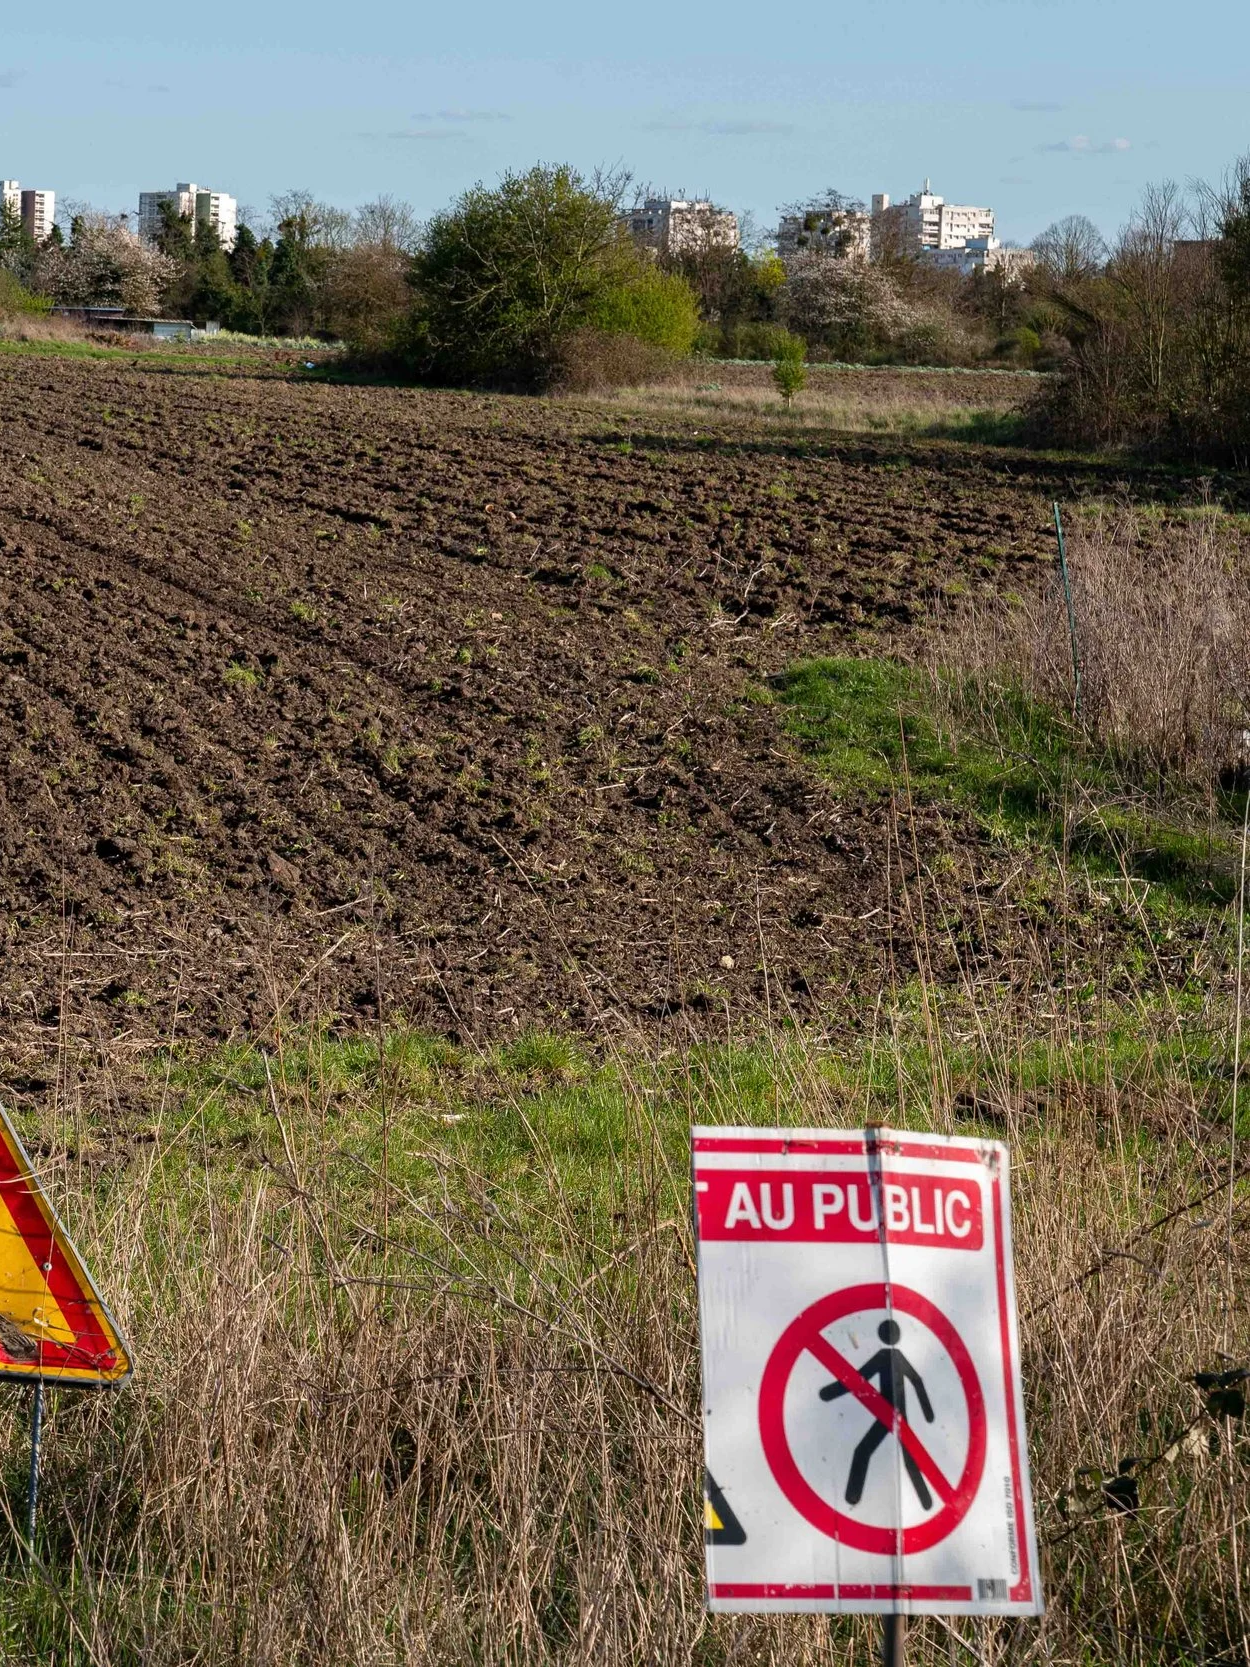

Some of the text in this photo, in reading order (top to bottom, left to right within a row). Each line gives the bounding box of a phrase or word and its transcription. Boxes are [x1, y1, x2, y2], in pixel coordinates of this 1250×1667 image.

[724, 1181, 972, 1239] AU PUBLIC
[1007, 1521, 1018, 1575] CONFORME
